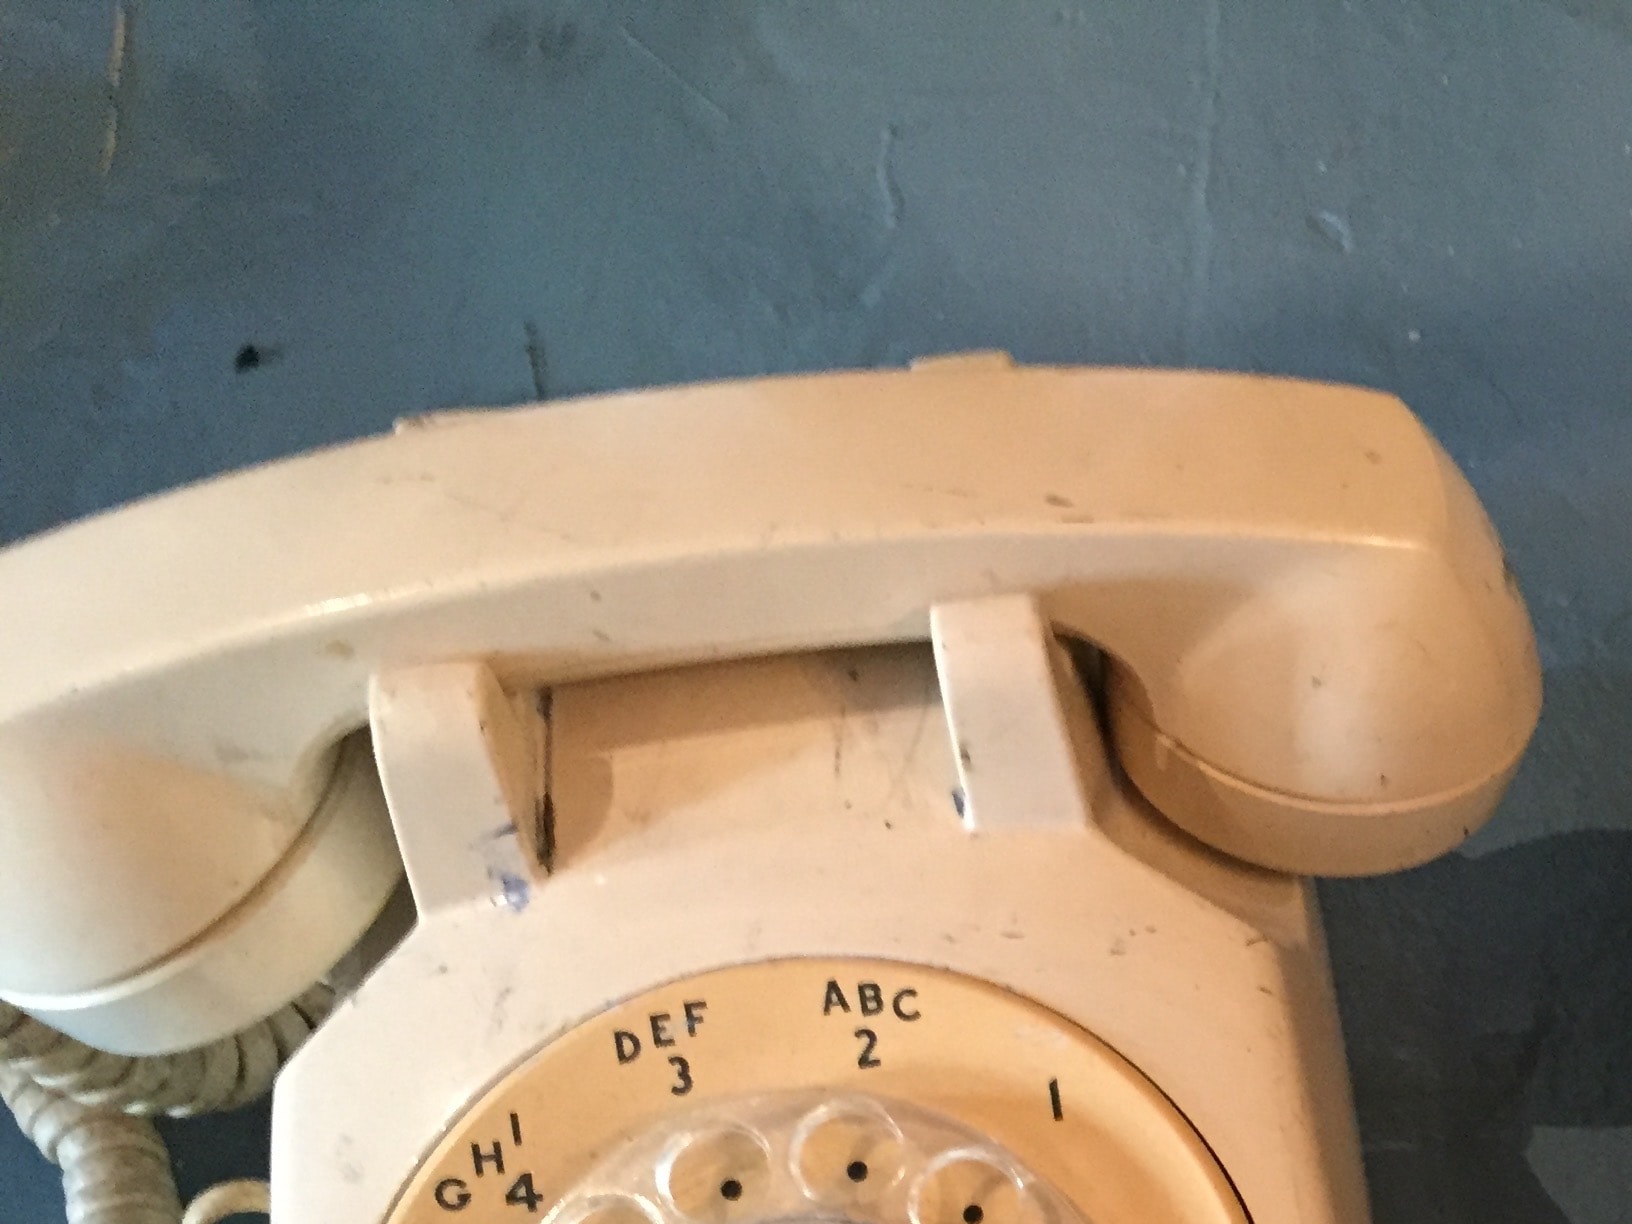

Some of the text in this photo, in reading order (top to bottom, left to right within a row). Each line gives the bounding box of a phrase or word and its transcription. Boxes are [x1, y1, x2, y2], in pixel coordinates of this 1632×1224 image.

[822, 980, 921, 1022] ABC
[613, 1000, 708, 1065] DEF
[854, 1028, 882, 1070] 2
[668, 1056, 692, 1096] 3
[505, 1173, 543, 1212] 4
